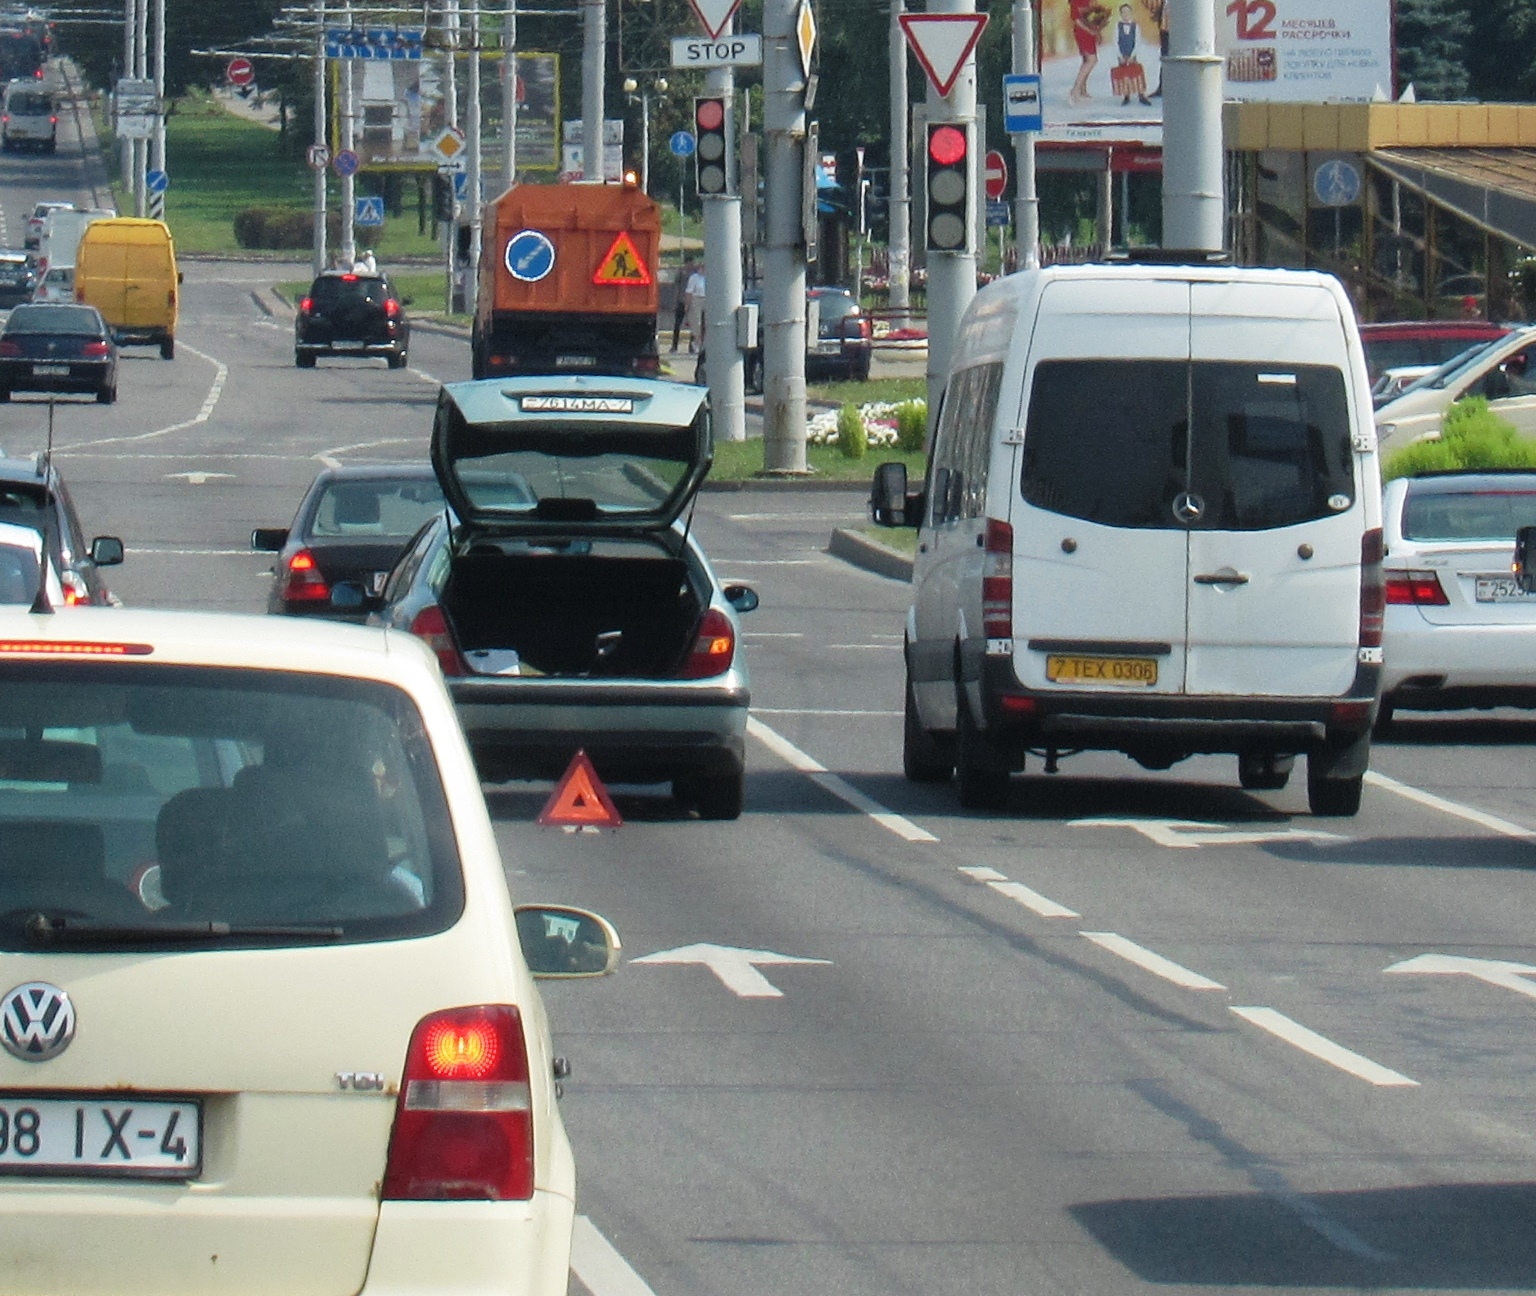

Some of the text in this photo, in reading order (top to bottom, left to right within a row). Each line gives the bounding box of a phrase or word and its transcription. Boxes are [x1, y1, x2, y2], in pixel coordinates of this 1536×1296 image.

[1281, 18, 1336, 29] МЕСЯЦЕВ
[1281, 30, 1352, 41] РАССРОЧКИ
[686, 42, 747, 61] STOP
[1070, 660, 1107, 678] TEX
